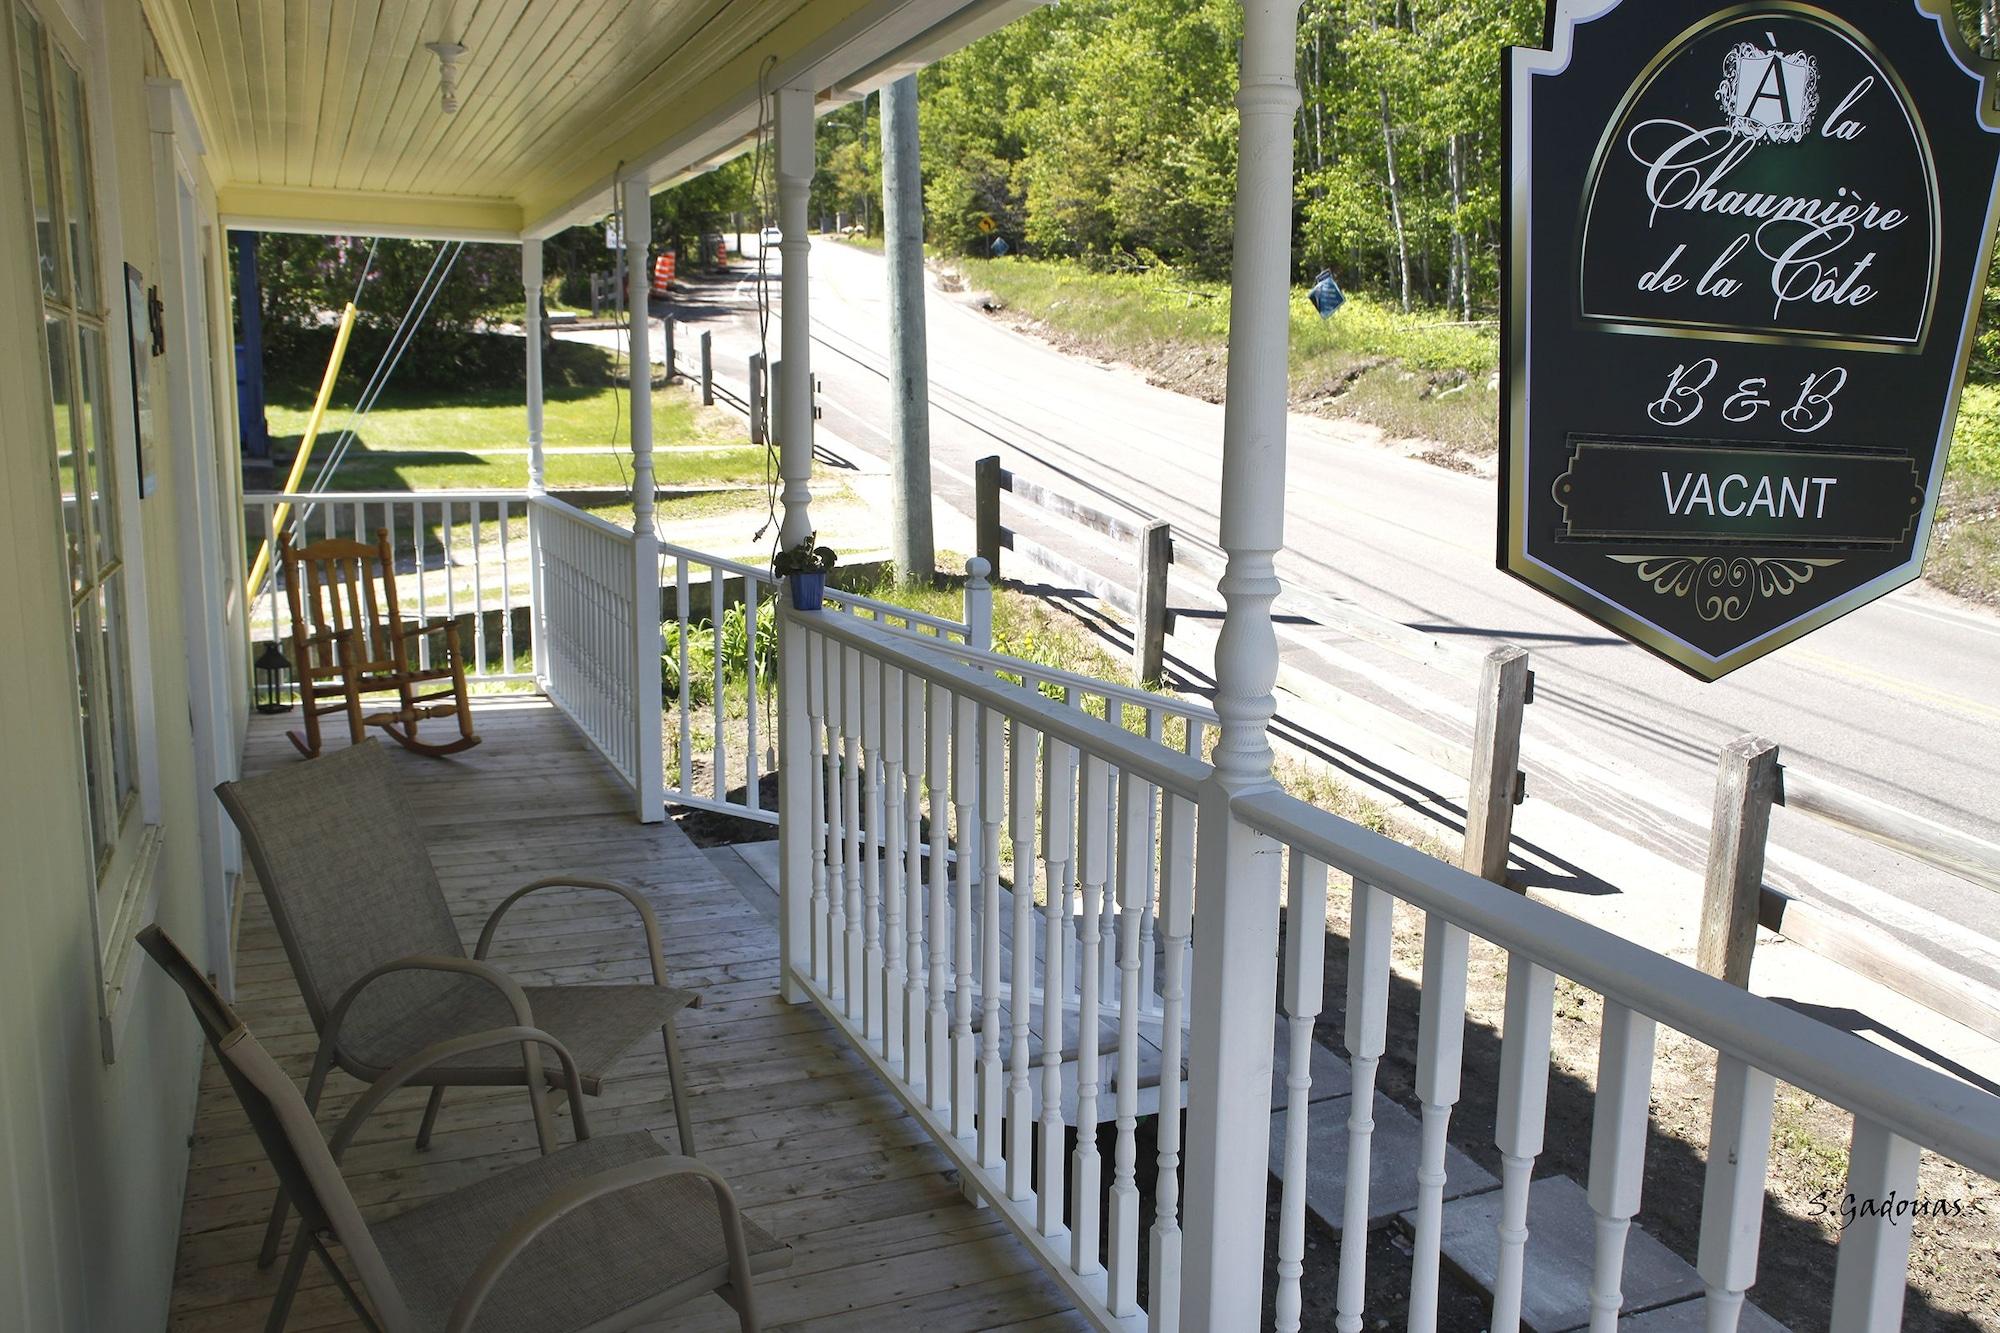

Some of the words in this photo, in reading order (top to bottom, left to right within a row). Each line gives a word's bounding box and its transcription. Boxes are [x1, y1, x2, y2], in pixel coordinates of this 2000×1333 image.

[1743, 31, 1793, 124] À
[1820, 75, 1876, 141] la
[1627, 118, 1909, 231] Chaumière
[1637, 243, 1690, 294] de
[1695, 233, 1751, 298] la
[1755, 217, 1879, 321] Côte
[1647, 357, 1719, 427] B
[1722, 377, 1771, 423] &
[1780, 366, 1848, 433] B
[1661, 471, 1838, 519] VACANT
